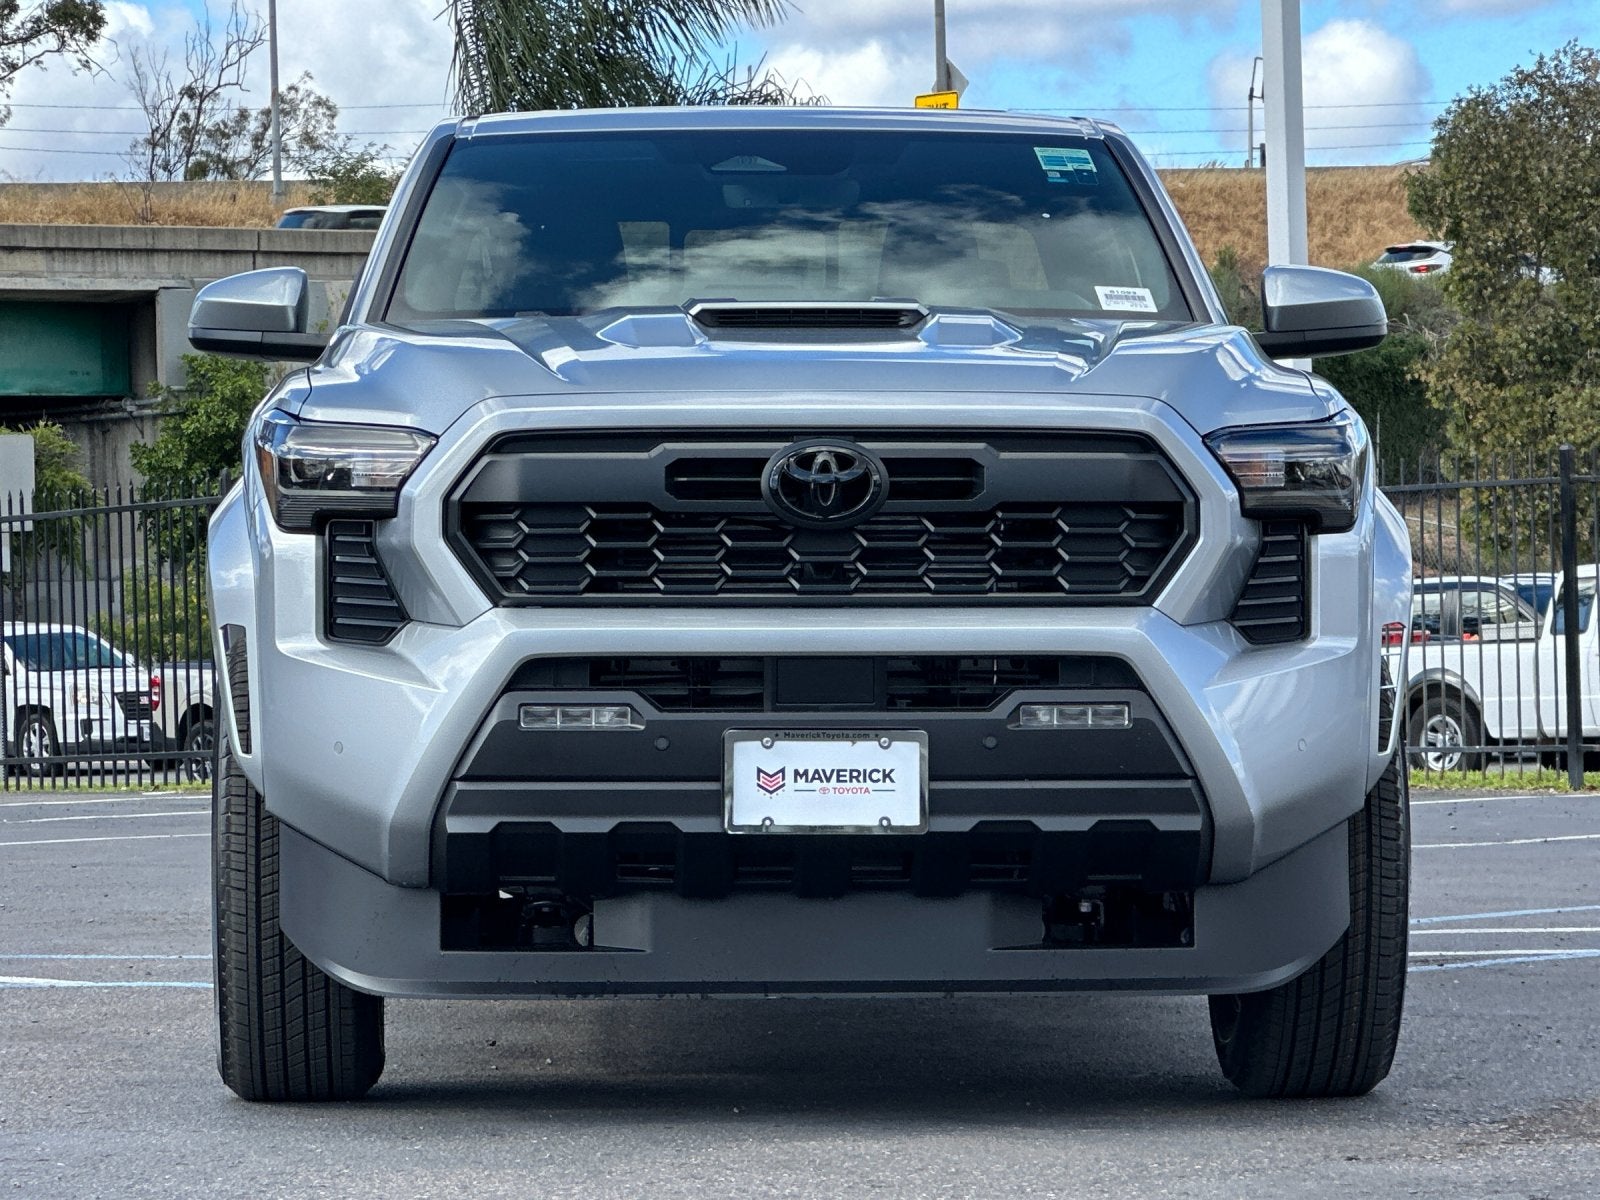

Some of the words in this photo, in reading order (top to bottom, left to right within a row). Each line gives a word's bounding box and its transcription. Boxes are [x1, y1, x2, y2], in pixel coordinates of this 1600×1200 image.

[783, 731, 870, 740] MaverickToyota.com
[793, 768, 896, 783] MAVERICK
[831, 787, 871, 795] TOYOTA
